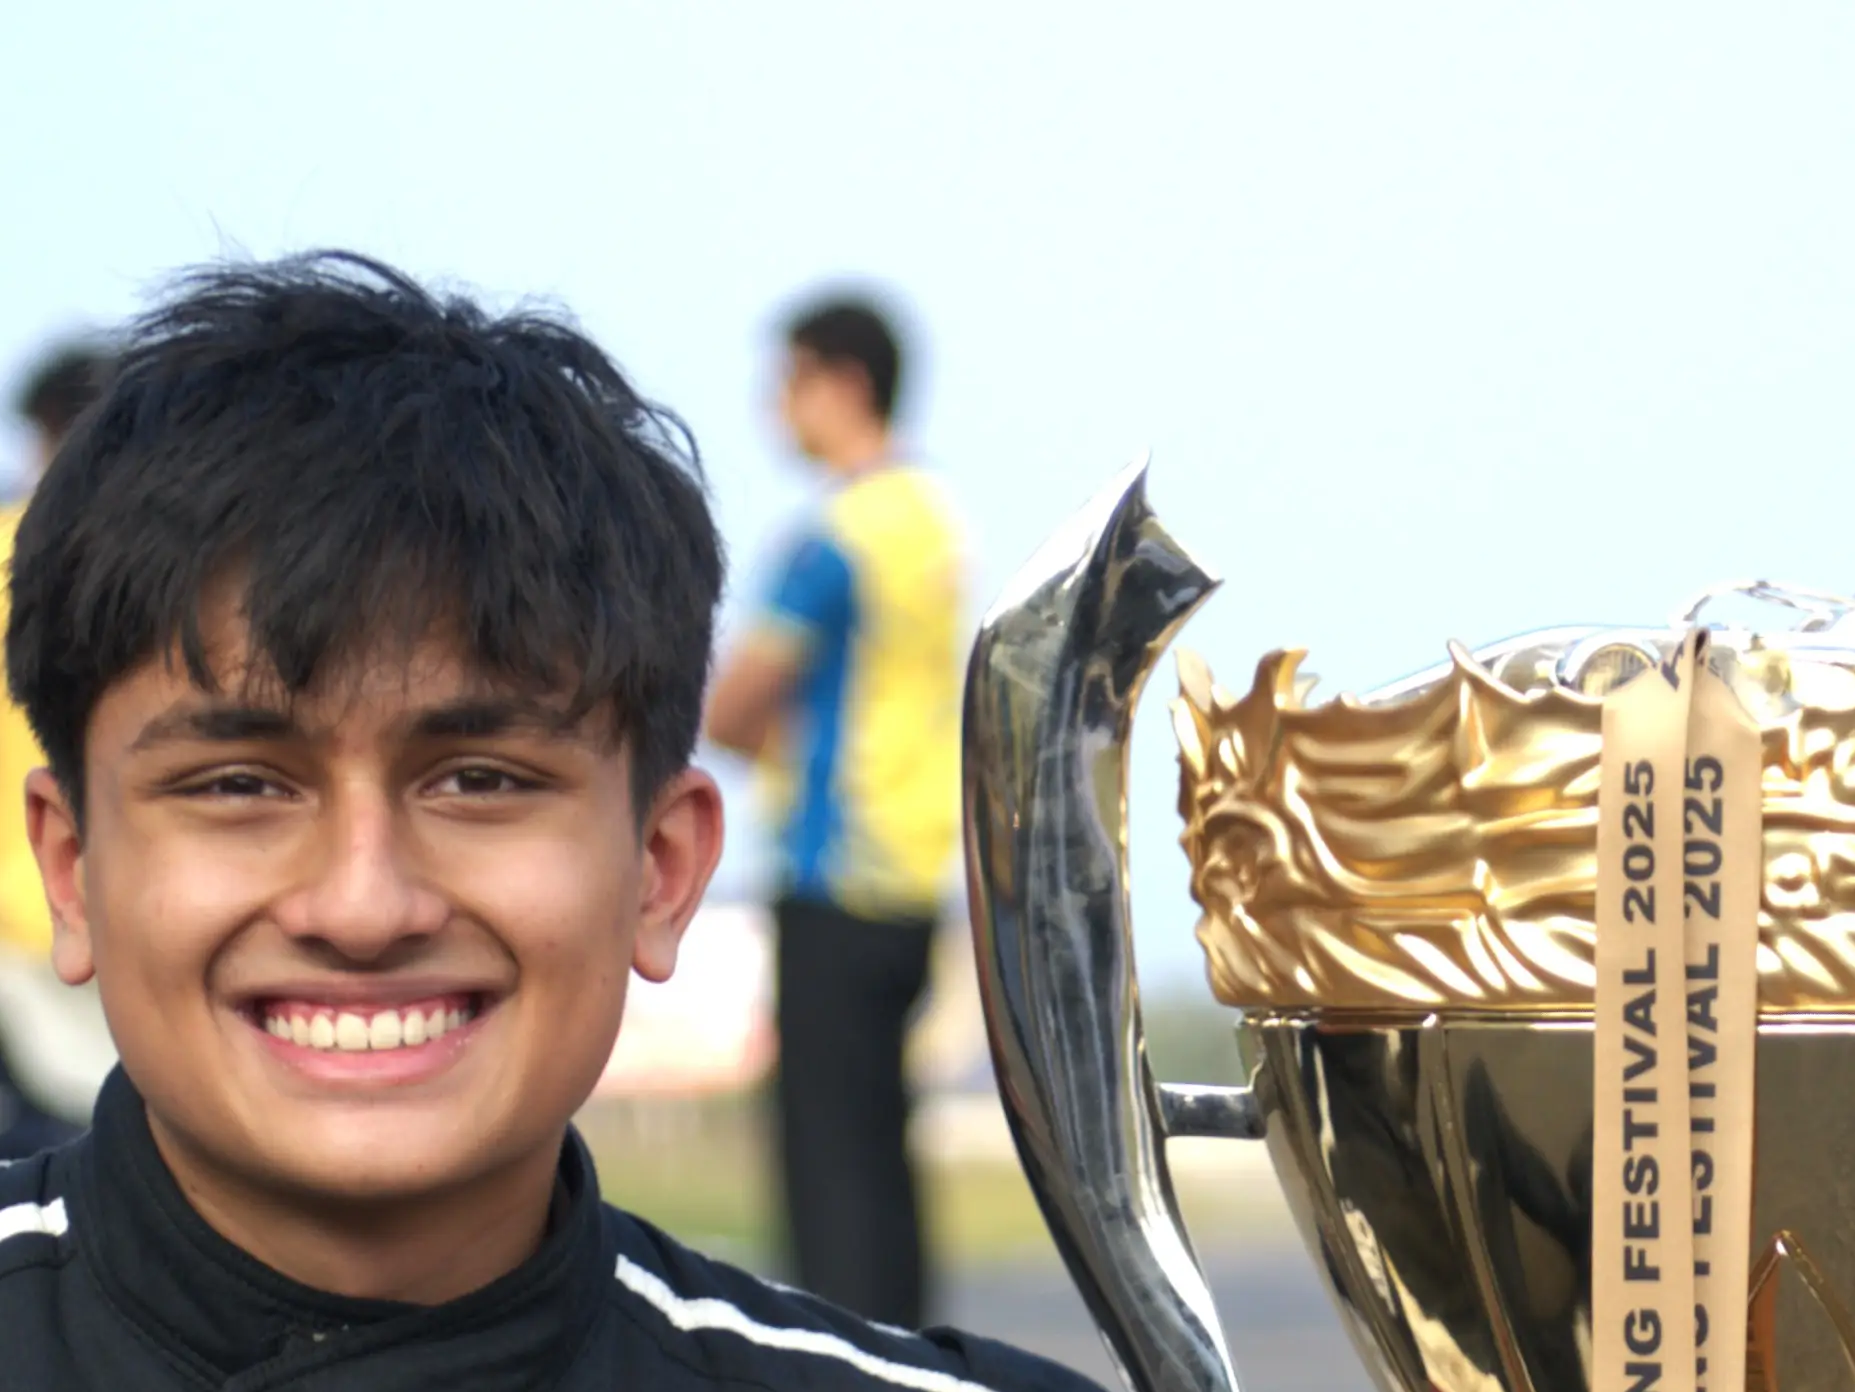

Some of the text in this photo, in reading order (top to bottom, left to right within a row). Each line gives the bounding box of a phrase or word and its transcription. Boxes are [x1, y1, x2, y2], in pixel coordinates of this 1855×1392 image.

[1622, 757, 1656, 926] 2025
[1683, 753, 1724, 921] 2025
[1622, 947, 1661, 1282] FESTIVAL
